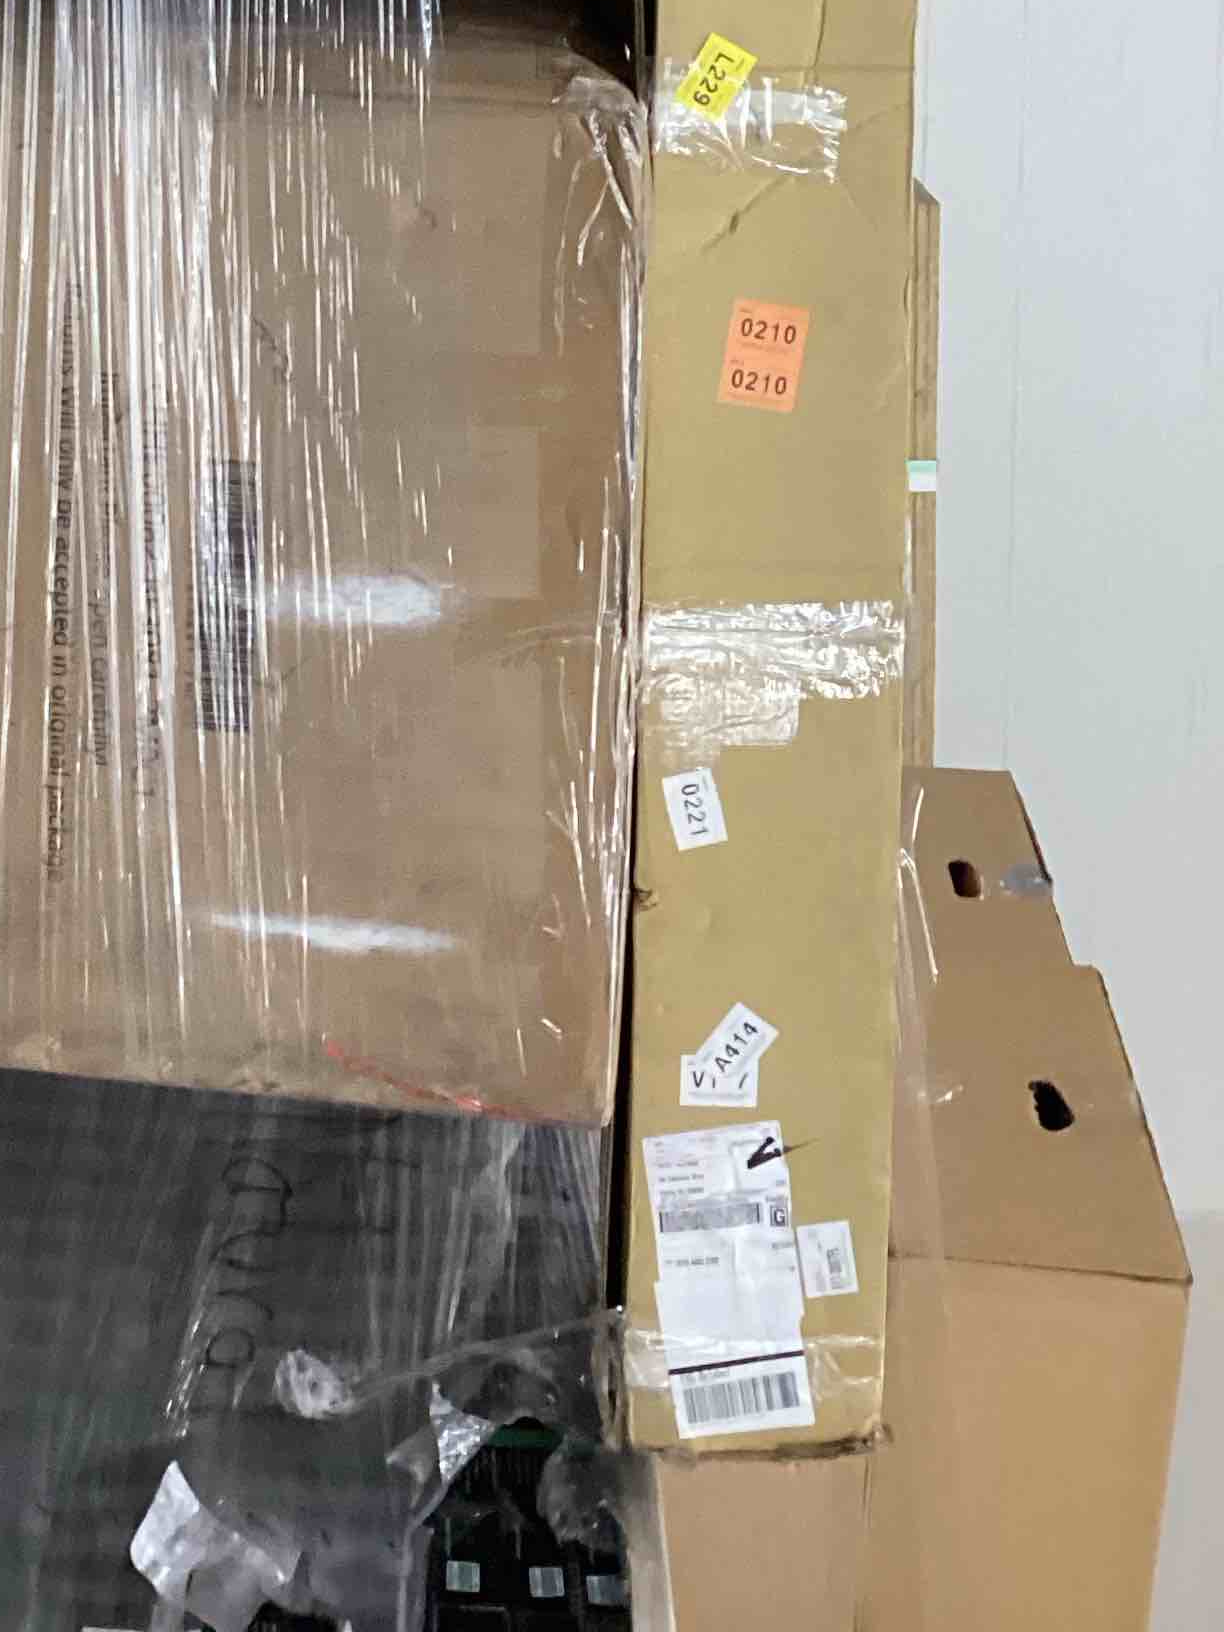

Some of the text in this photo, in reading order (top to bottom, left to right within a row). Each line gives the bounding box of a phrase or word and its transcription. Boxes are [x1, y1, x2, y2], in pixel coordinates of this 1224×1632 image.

[693, 51, 734, 108] L229
[740, 317, 797, 346] 0210
[731, 368, 787, 396] 0210
[51, 535, 73, 646] accepted
[52, 655, 72, 677] in
[47, 684, 73, 777] original
[45, 784, 70, 884] package
[714, 1021, 760, 1073] A414
